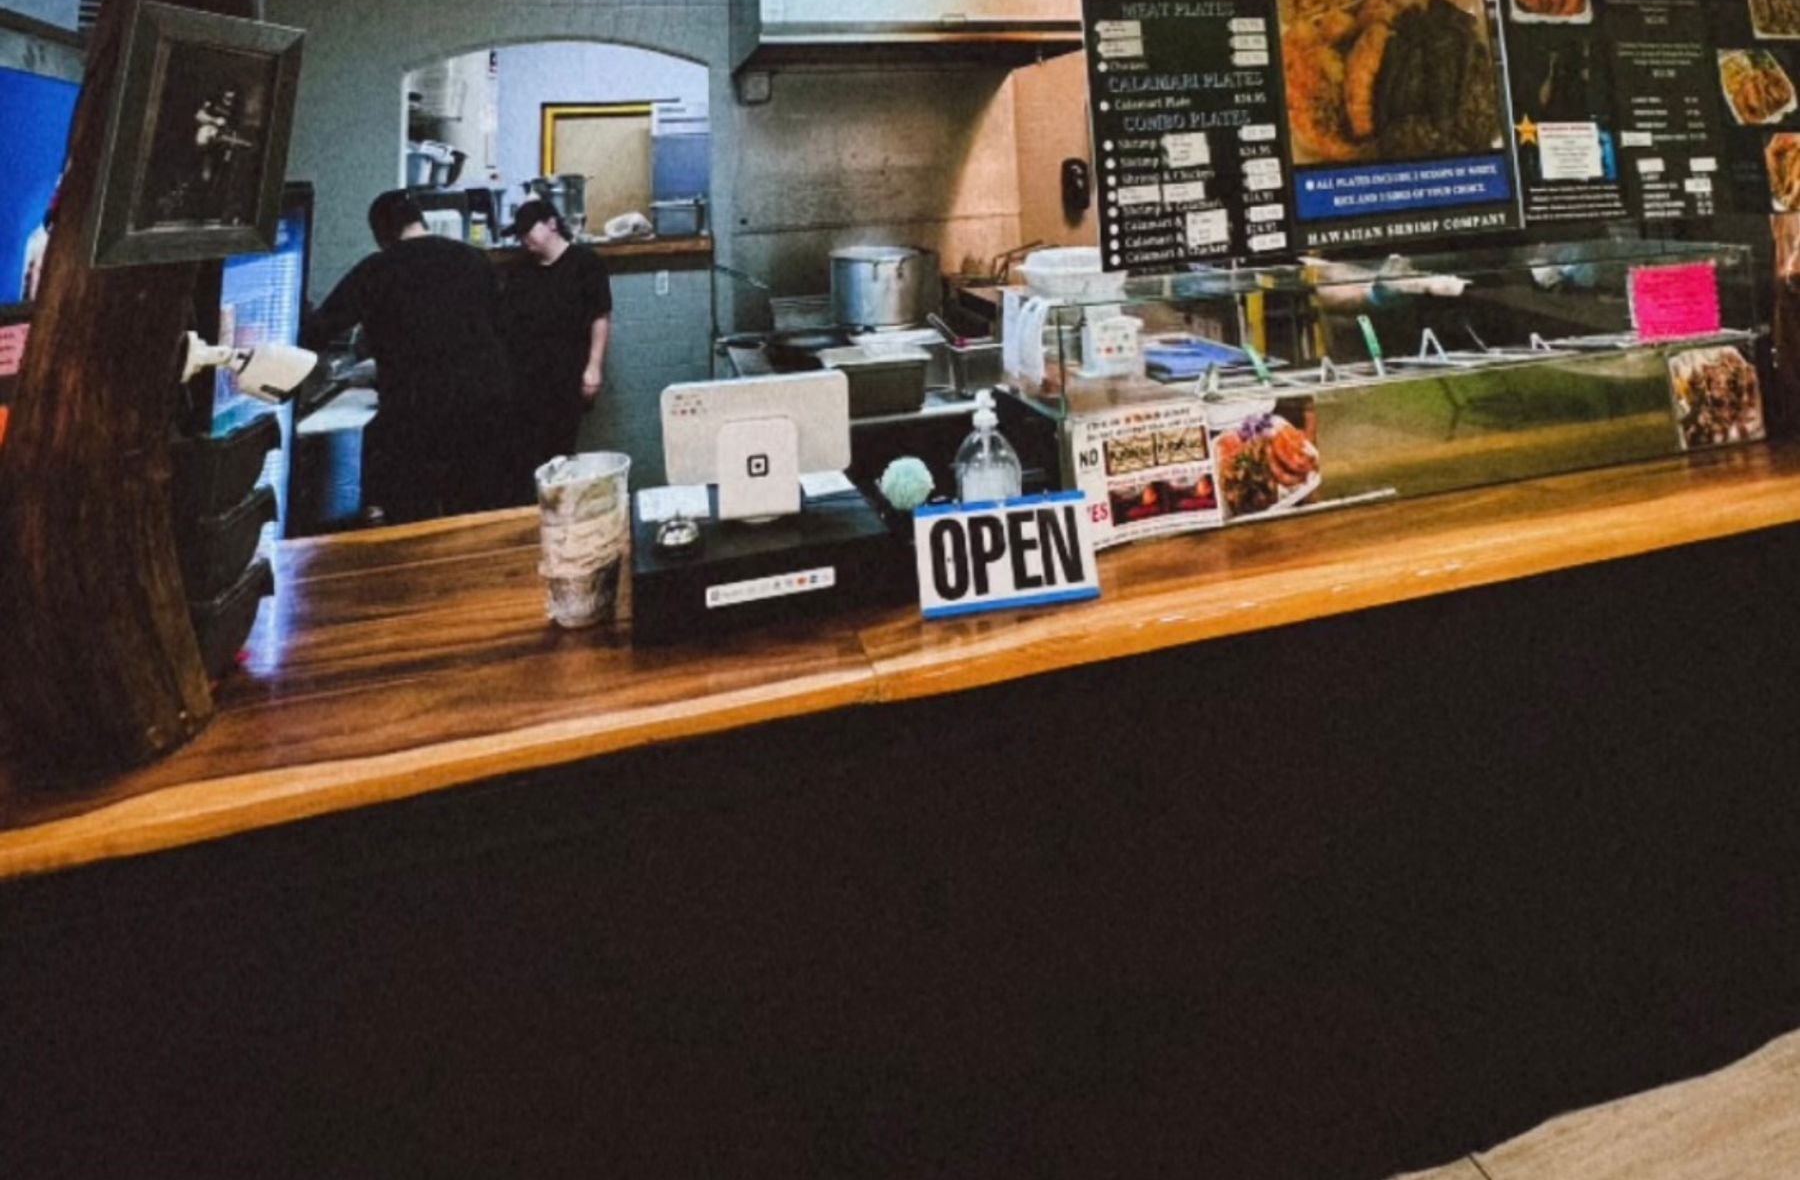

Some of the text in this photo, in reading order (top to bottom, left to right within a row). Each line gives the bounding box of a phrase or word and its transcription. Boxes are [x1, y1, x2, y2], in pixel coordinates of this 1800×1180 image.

[1122, 1, 1235, 19] MEAT PLATES
[1108, 71, 1264, 93] CALAMARI PLATES
[1123, 110, 1252, 132] COMBO PLATES
[1307, 212, 1507, 246] HAWAIIAN SHRIMP COMPANY
[1079, 449, 1098, 469] NO
[930, 505, 1085, 601] OPEN
